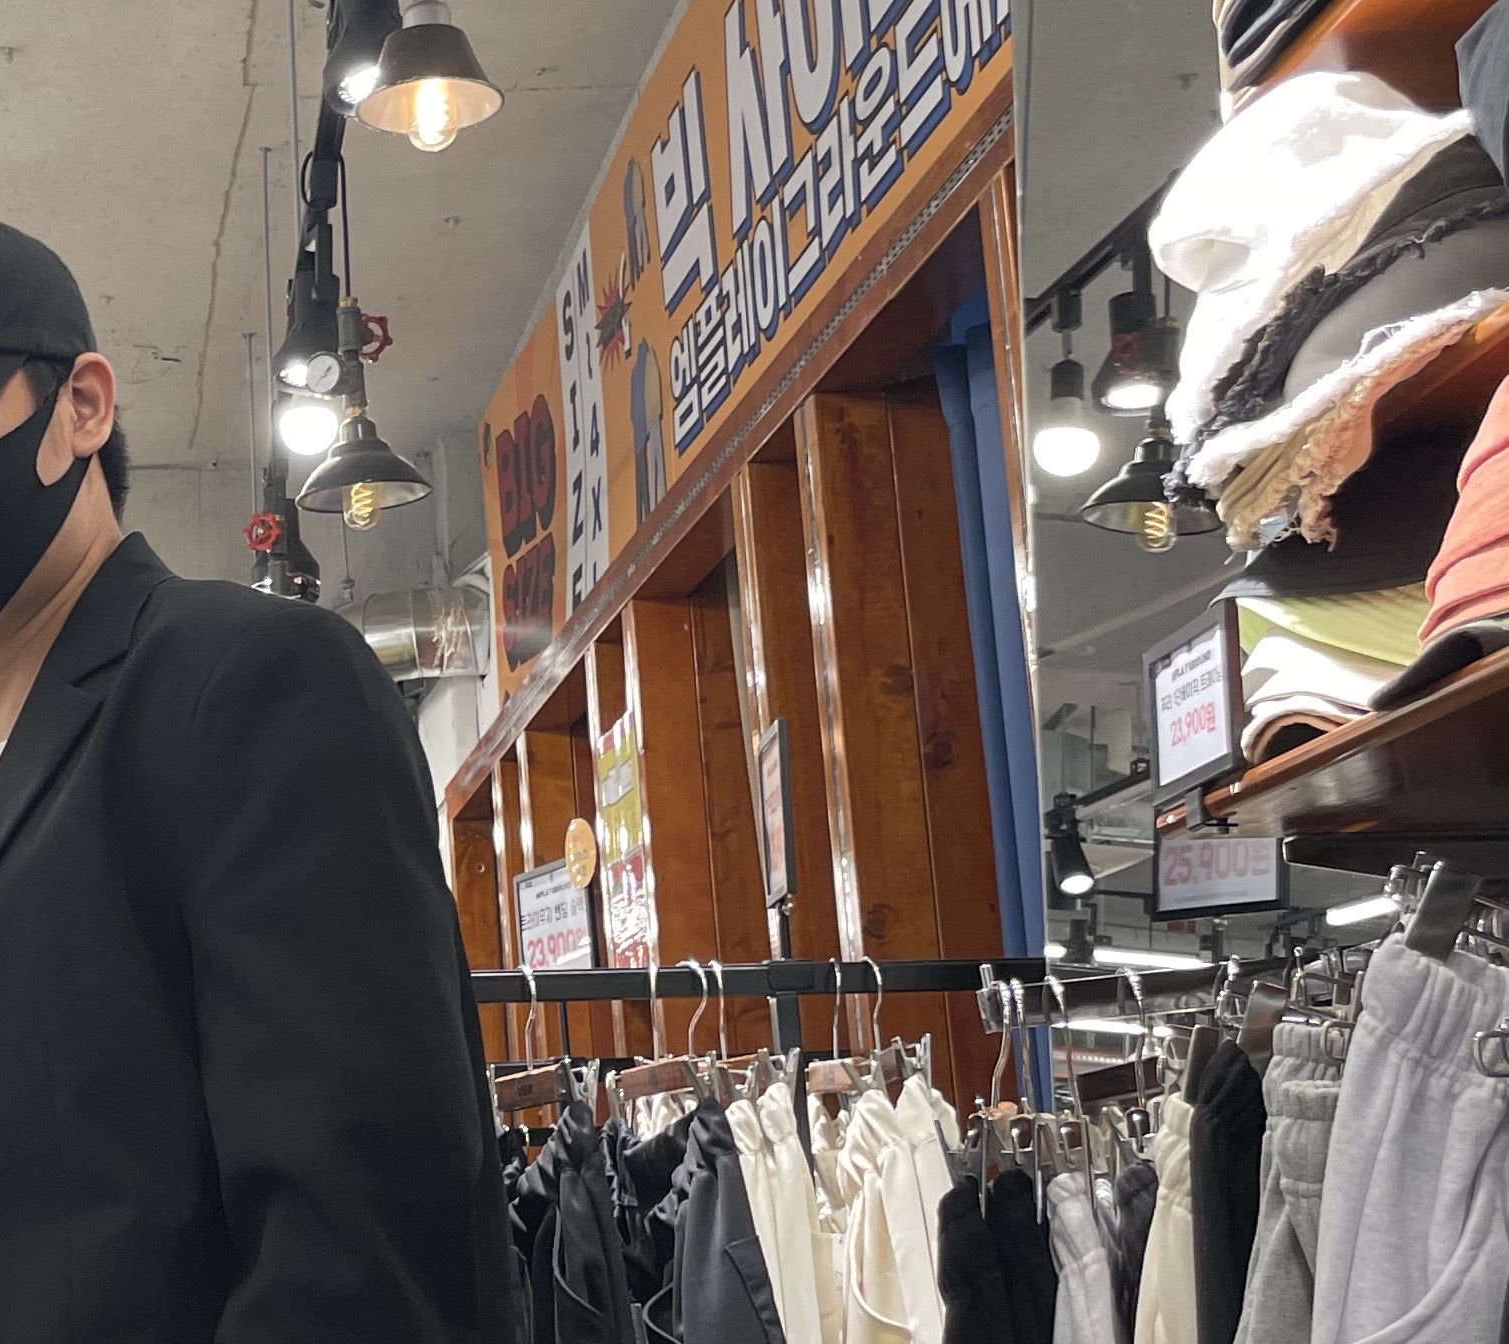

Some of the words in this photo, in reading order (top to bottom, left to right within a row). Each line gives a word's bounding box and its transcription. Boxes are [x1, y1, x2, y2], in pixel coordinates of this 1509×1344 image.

[650, 68, 719, 318] 빅
[495, 393, 556, 559] BIG
[501, 531, 554, 672] SIZE
